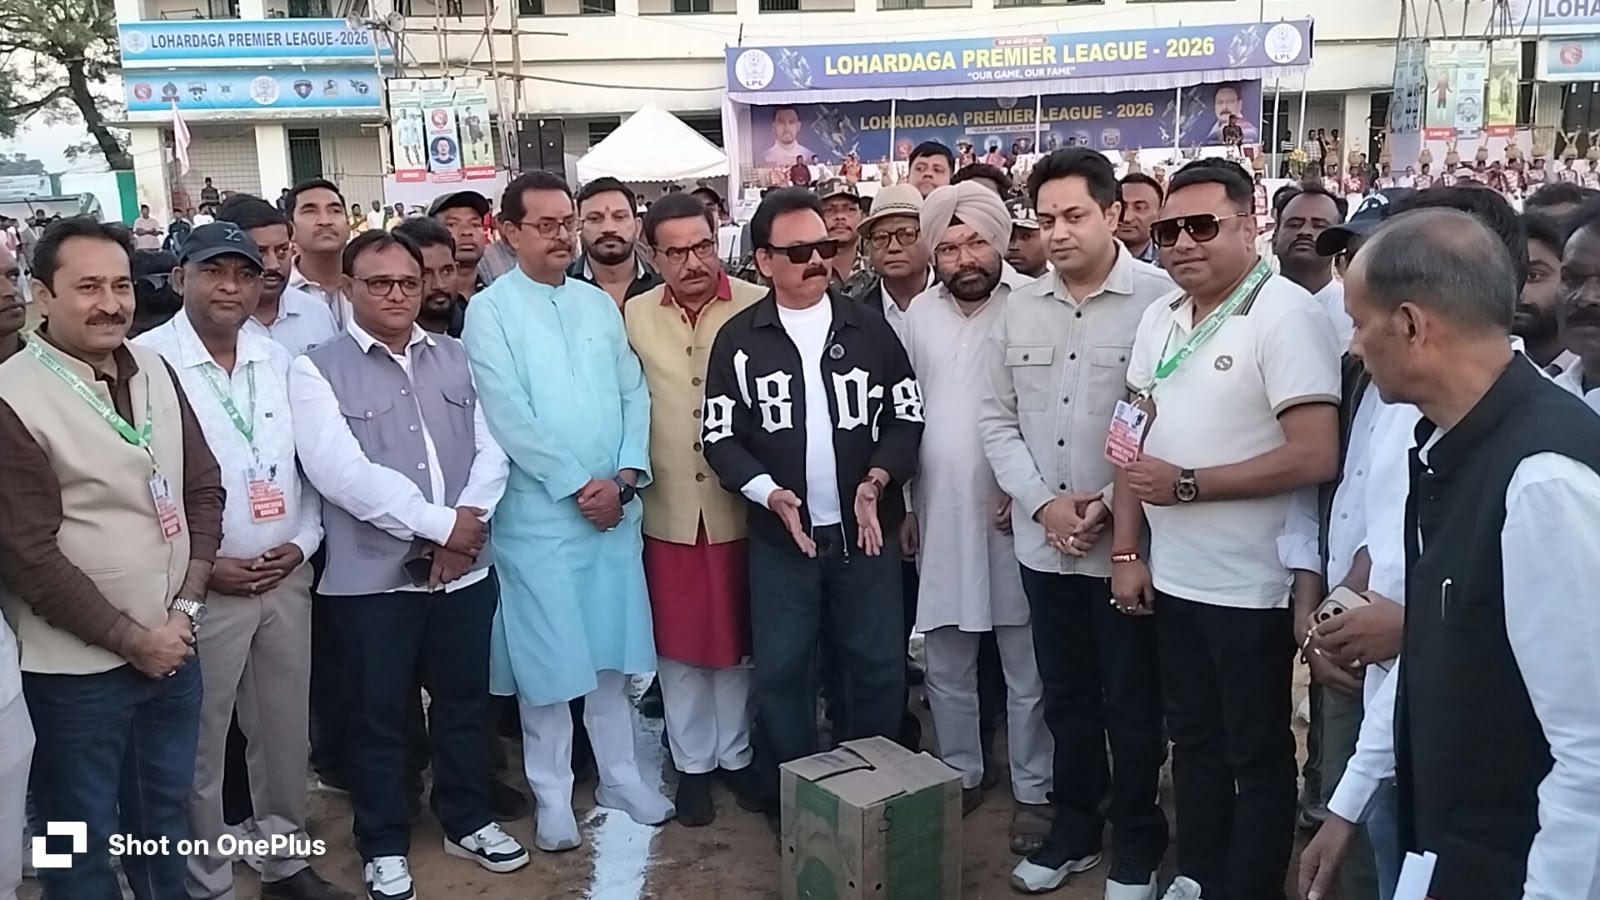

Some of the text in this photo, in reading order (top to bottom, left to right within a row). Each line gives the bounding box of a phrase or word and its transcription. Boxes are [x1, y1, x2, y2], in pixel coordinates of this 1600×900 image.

[151, 31, 225, 48] LOHARDAGA
[229, 31, 282, 47] PREMIER
[825, 50, 956, 76] LOHARDAGA
[962, 46, 1057, 69] PREMIER
[1063, 41, 1147, 65] LEAGUE
[1165, 37, 1215, 58] 2026
[1025, 68, 1045, 77] OUR
[860, 111, 958, 130] LOHARDAGA
[963, 108, 1034, 125] PREMIER
[1039, 105, 1103, 122] LEAGUE
[1116, 102, 1154, 118] 2026
